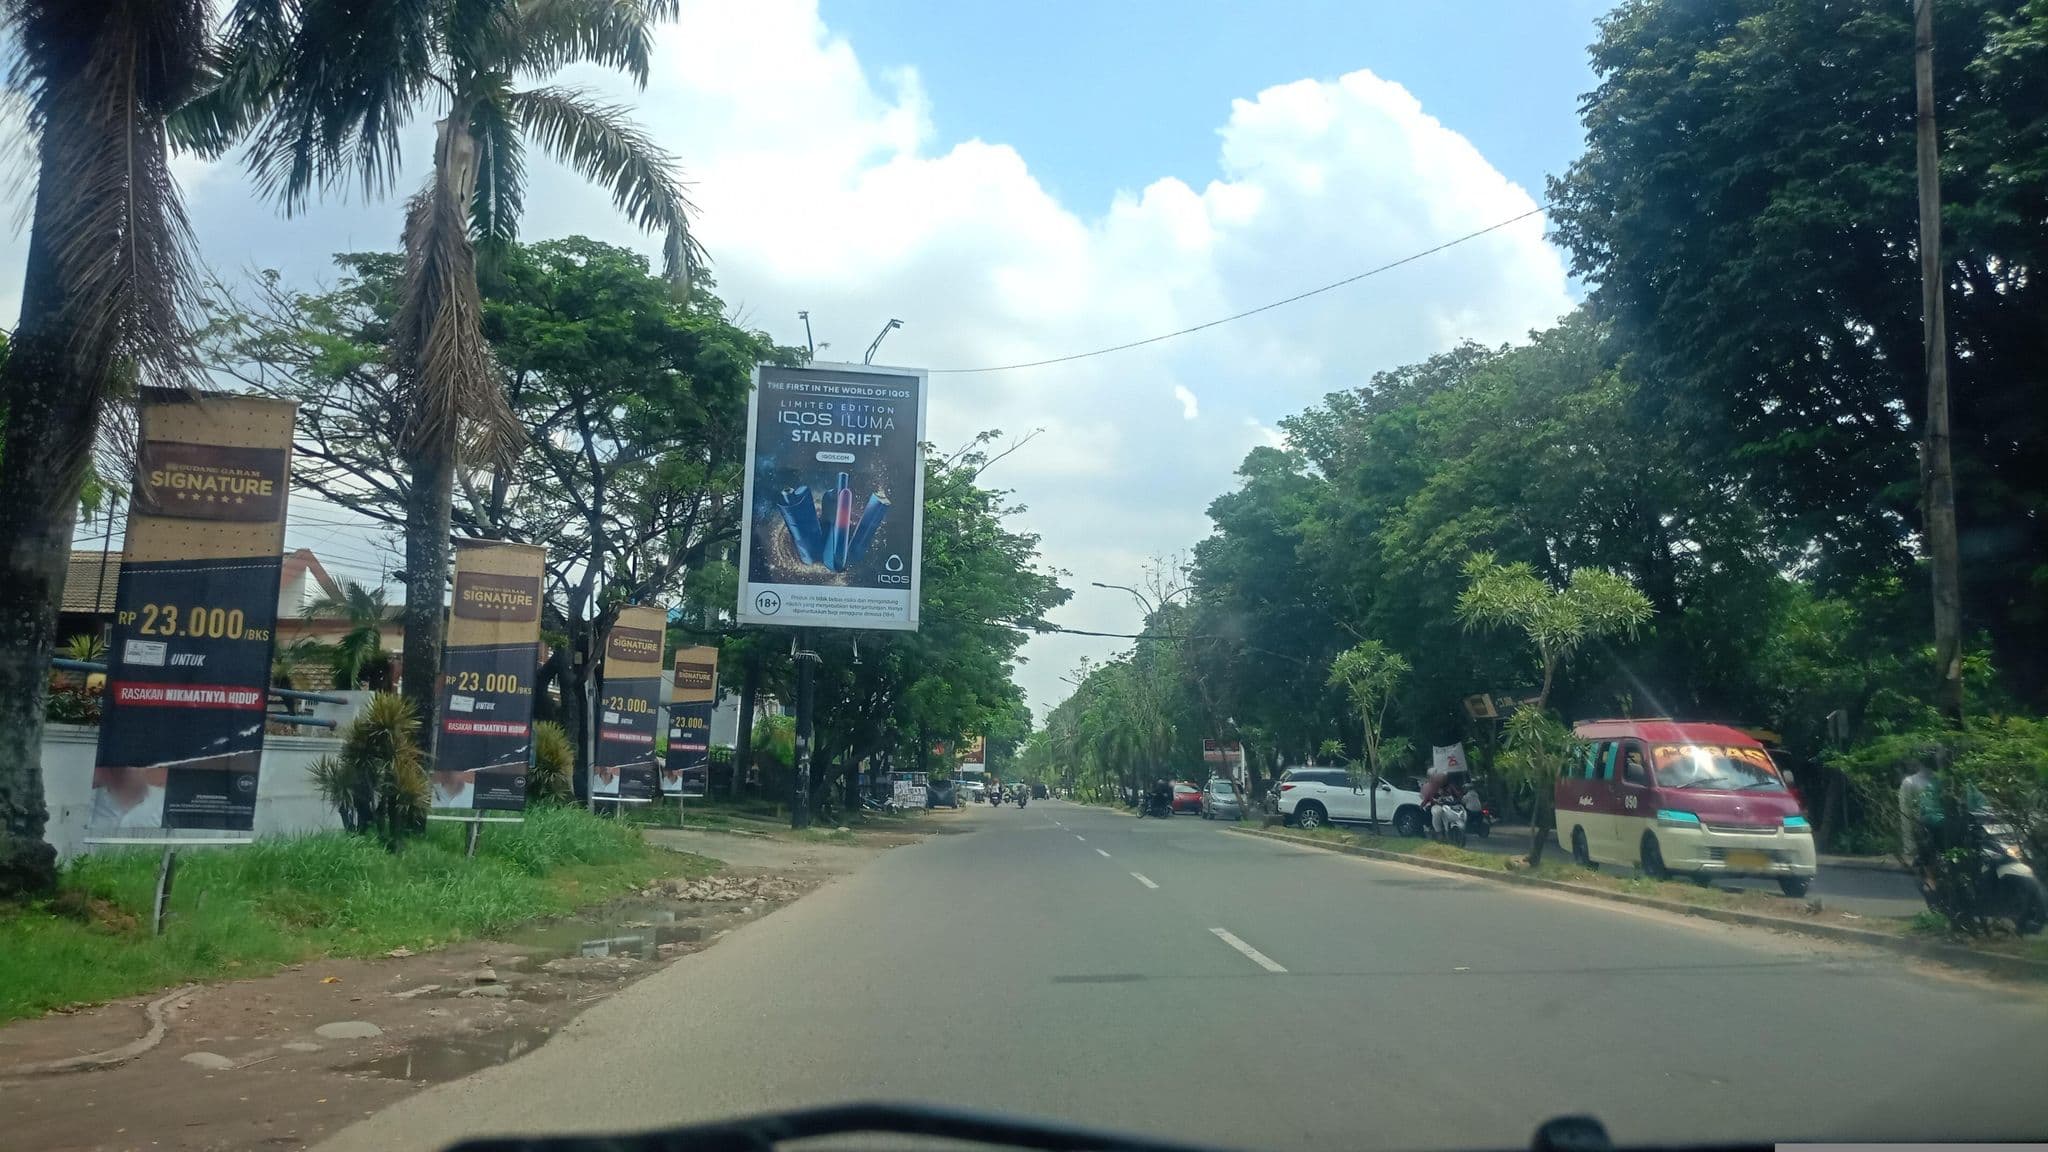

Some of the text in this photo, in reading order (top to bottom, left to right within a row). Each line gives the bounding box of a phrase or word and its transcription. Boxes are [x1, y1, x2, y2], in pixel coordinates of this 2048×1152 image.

[767, 382, 784, 390] THE
[786, 383, 810, 392] FIRST
[841, 387, 873, 396] WORLD
[875, 389, 886, 397] OF
[889, 390, 910, 398] IQOS
[781, 400, 895, 414] LIMITED EDITION
[778, 410, 895, 430] IQOS ILUMA
[792, 430, 883, 447] STARDRIFT
[220, 468, 260, 478] GARAM
[151, 470, 273, 496] SIGNATURE
[878, 574, 910, 584] IQOS
[464, 590, 533, 606] SIGNATURE
[758, 598, 778, 607] 18+
[118, 611, 136, 625] RP
[614, 638, 658, 651] SIGNATURE
[170, 654, 206, 666] UNTUK
[446, 676, 457, 685] RP
[122, 688, 259, 705] RASAKAN NIKMATNYA HIDUP
